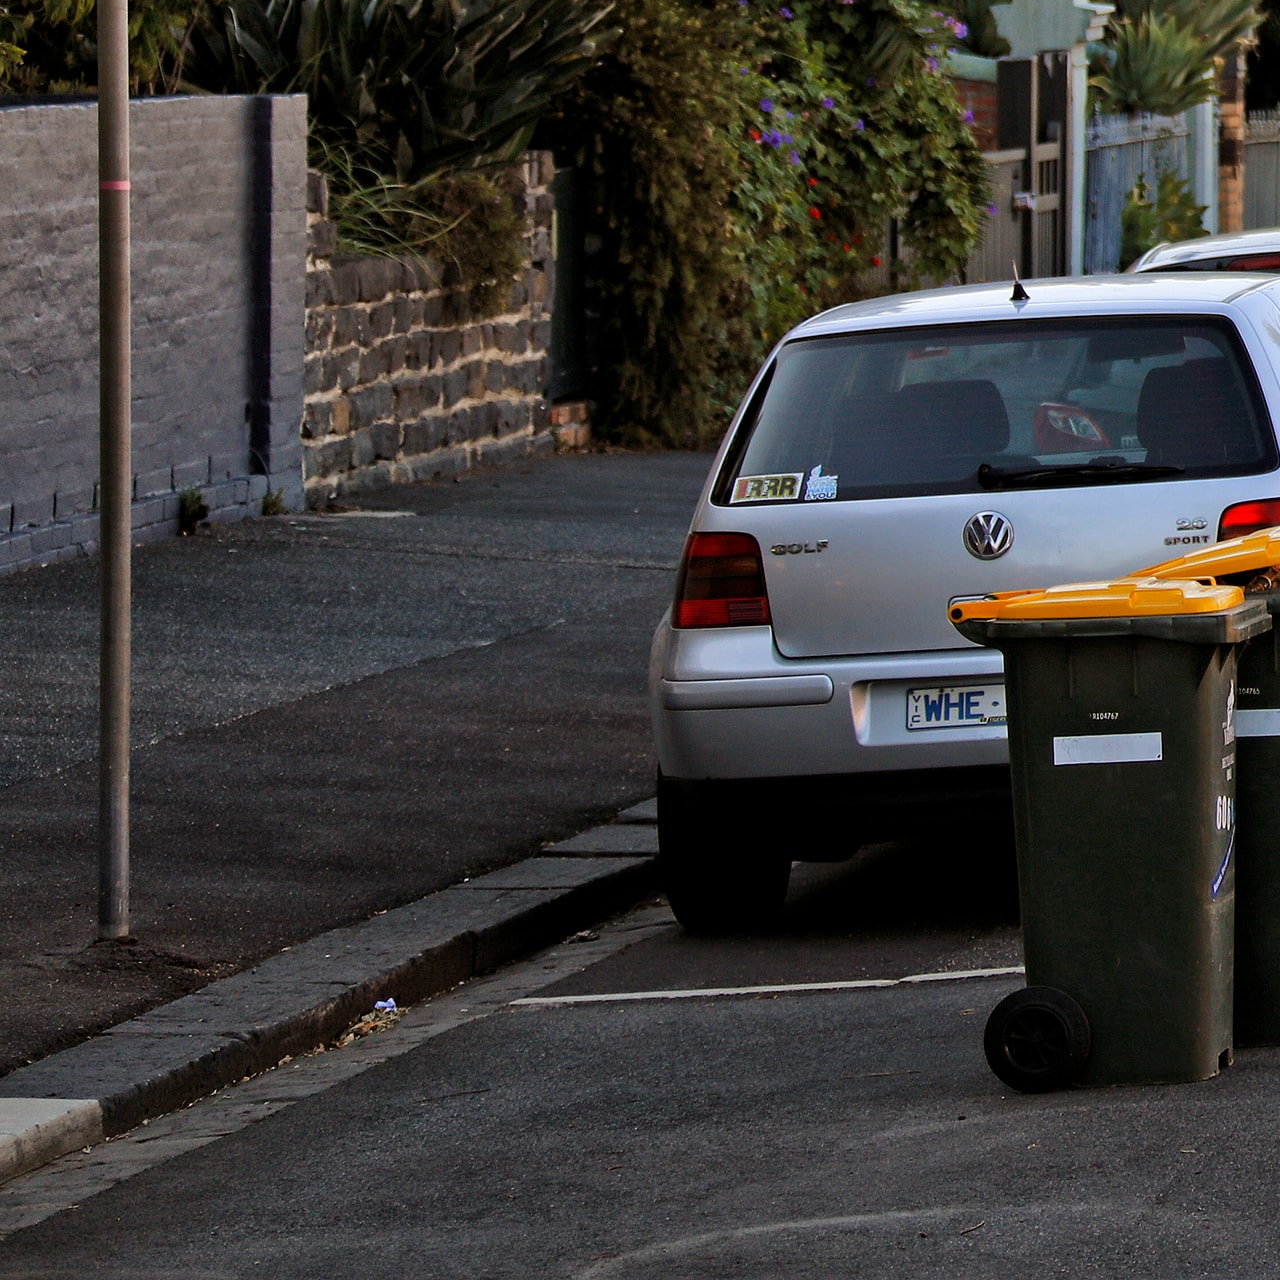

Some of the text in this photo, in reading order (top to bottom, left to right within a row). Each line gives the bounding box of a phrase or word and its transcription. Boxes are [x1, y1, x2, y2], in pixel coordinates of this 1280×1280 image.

[770, 539, 829, 556] GOLF
[1164, 535, 1209, 546] SPORT
[911, 695, 921, 723] VIC
